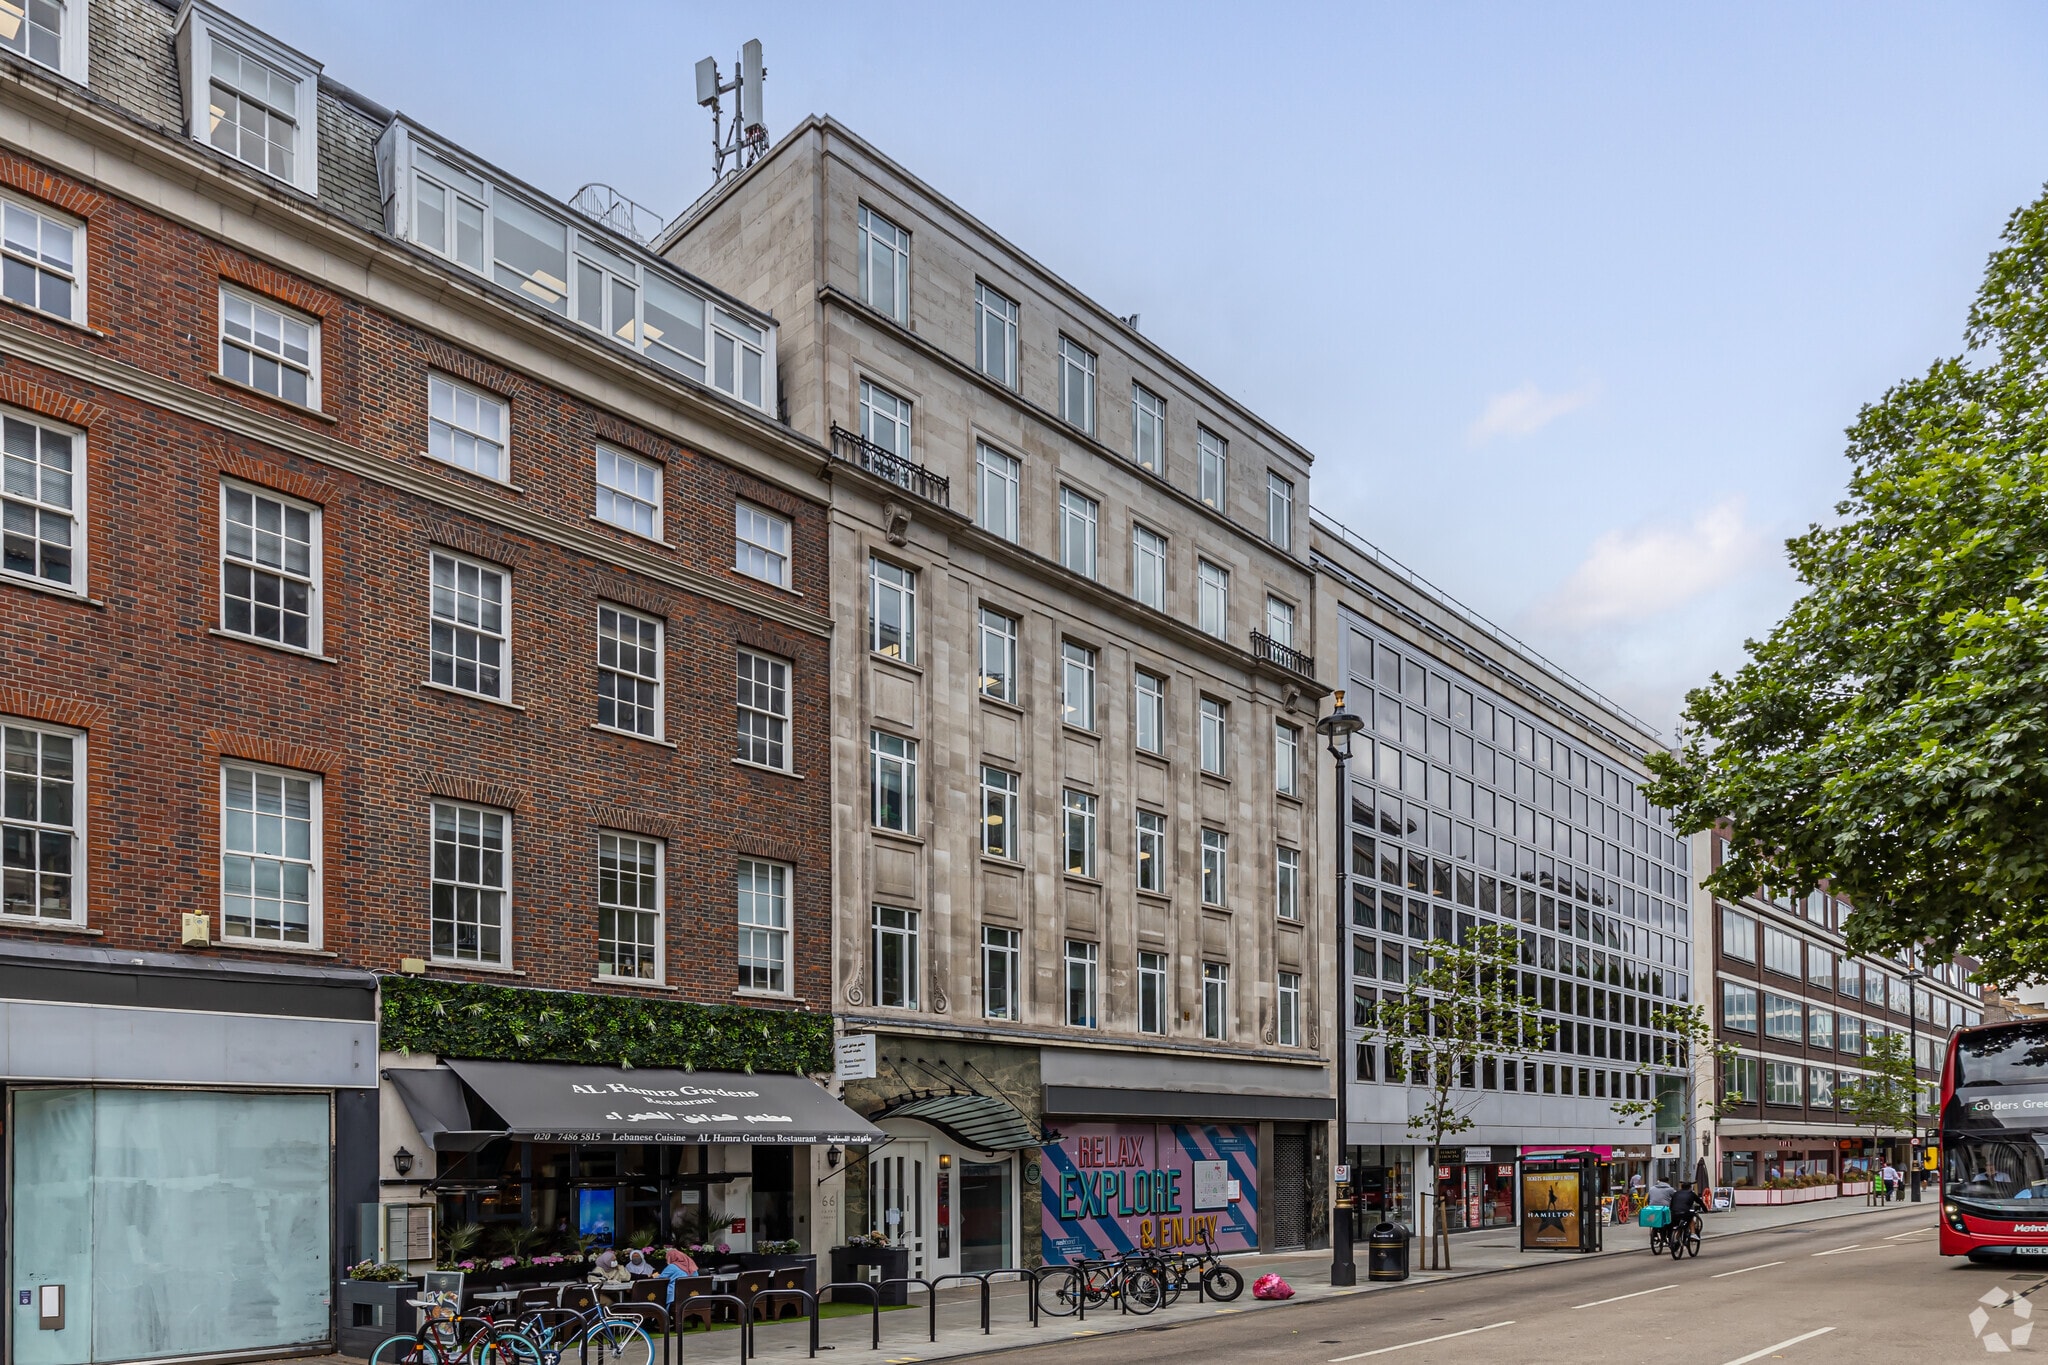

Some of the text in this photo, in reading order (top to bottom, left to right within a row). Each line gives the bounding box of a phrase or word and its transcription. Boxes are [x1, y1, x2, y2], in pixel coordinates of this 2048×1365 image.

[571, 1083, 759, 1098] AL Hamra Gardens
[642, 1096, 717, 1106] Restaurant
[1975, 1101, 2019, 1111] Golders
[534, 1132, 817, 1143] 020 7486 5815 Lebanese Cuisine AL Hamra Gardens Restaurant
[1079, 1136, 1144, 1168] RELAX
[1439, 1168, 1449, 1177] ALE
[1498, 1166, 1512, 1175] SALE
[1060, 1169, 1182, 1219] EXPLORE
[821, 1195, 836, 1207] 66
[1140, 1215, 1218, 1249] & ENJOY
